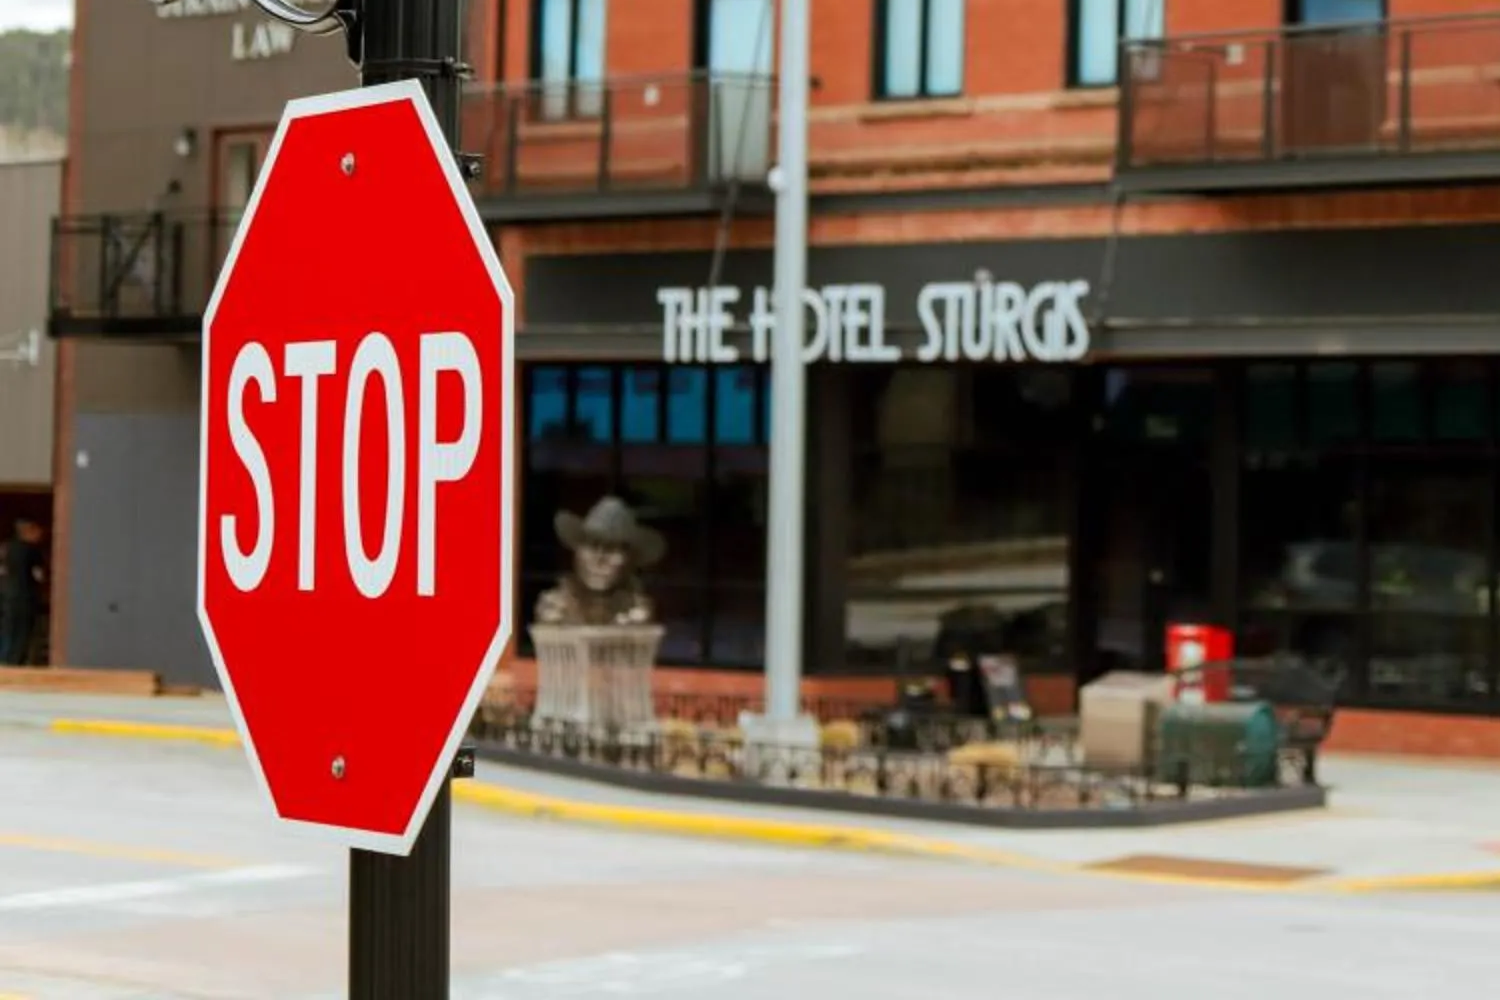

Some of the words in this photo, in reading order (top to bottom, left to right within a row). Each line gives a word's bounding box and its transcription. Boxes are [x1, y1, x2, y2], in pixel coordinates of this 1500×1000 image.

[657, 284, 740, 363] THE
[917, 279, 1090, 363] STURGIS
[220, 331, 483, 598] STOP
